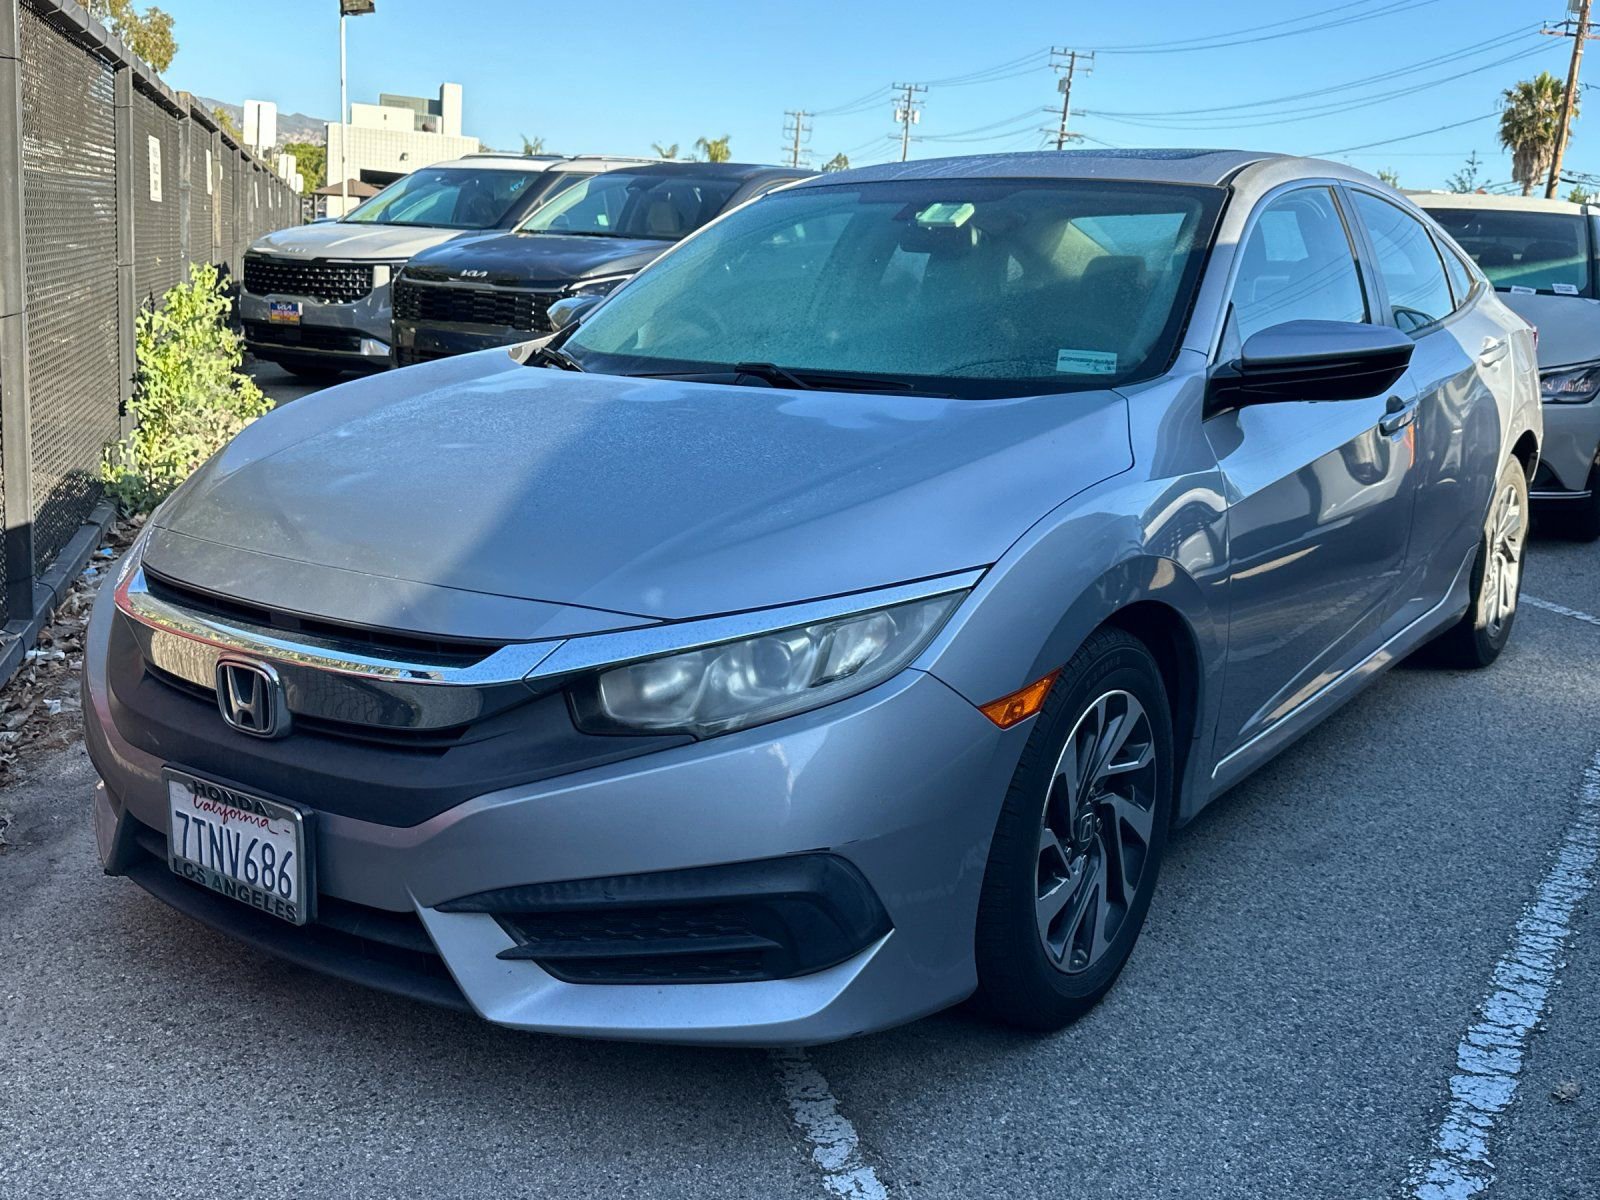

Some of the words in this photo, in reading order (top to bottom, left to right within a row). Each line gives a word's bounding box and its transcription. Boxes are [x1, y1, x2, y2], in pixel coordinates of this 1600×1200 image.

[193, 780, 269, 818] HONDA
[193, 794, 278, 835] California
[175, 810, 293, 900] 7TNV686
[173, 858, 206, 885] LOS
[212, 875, 297, 922] ANGELES
